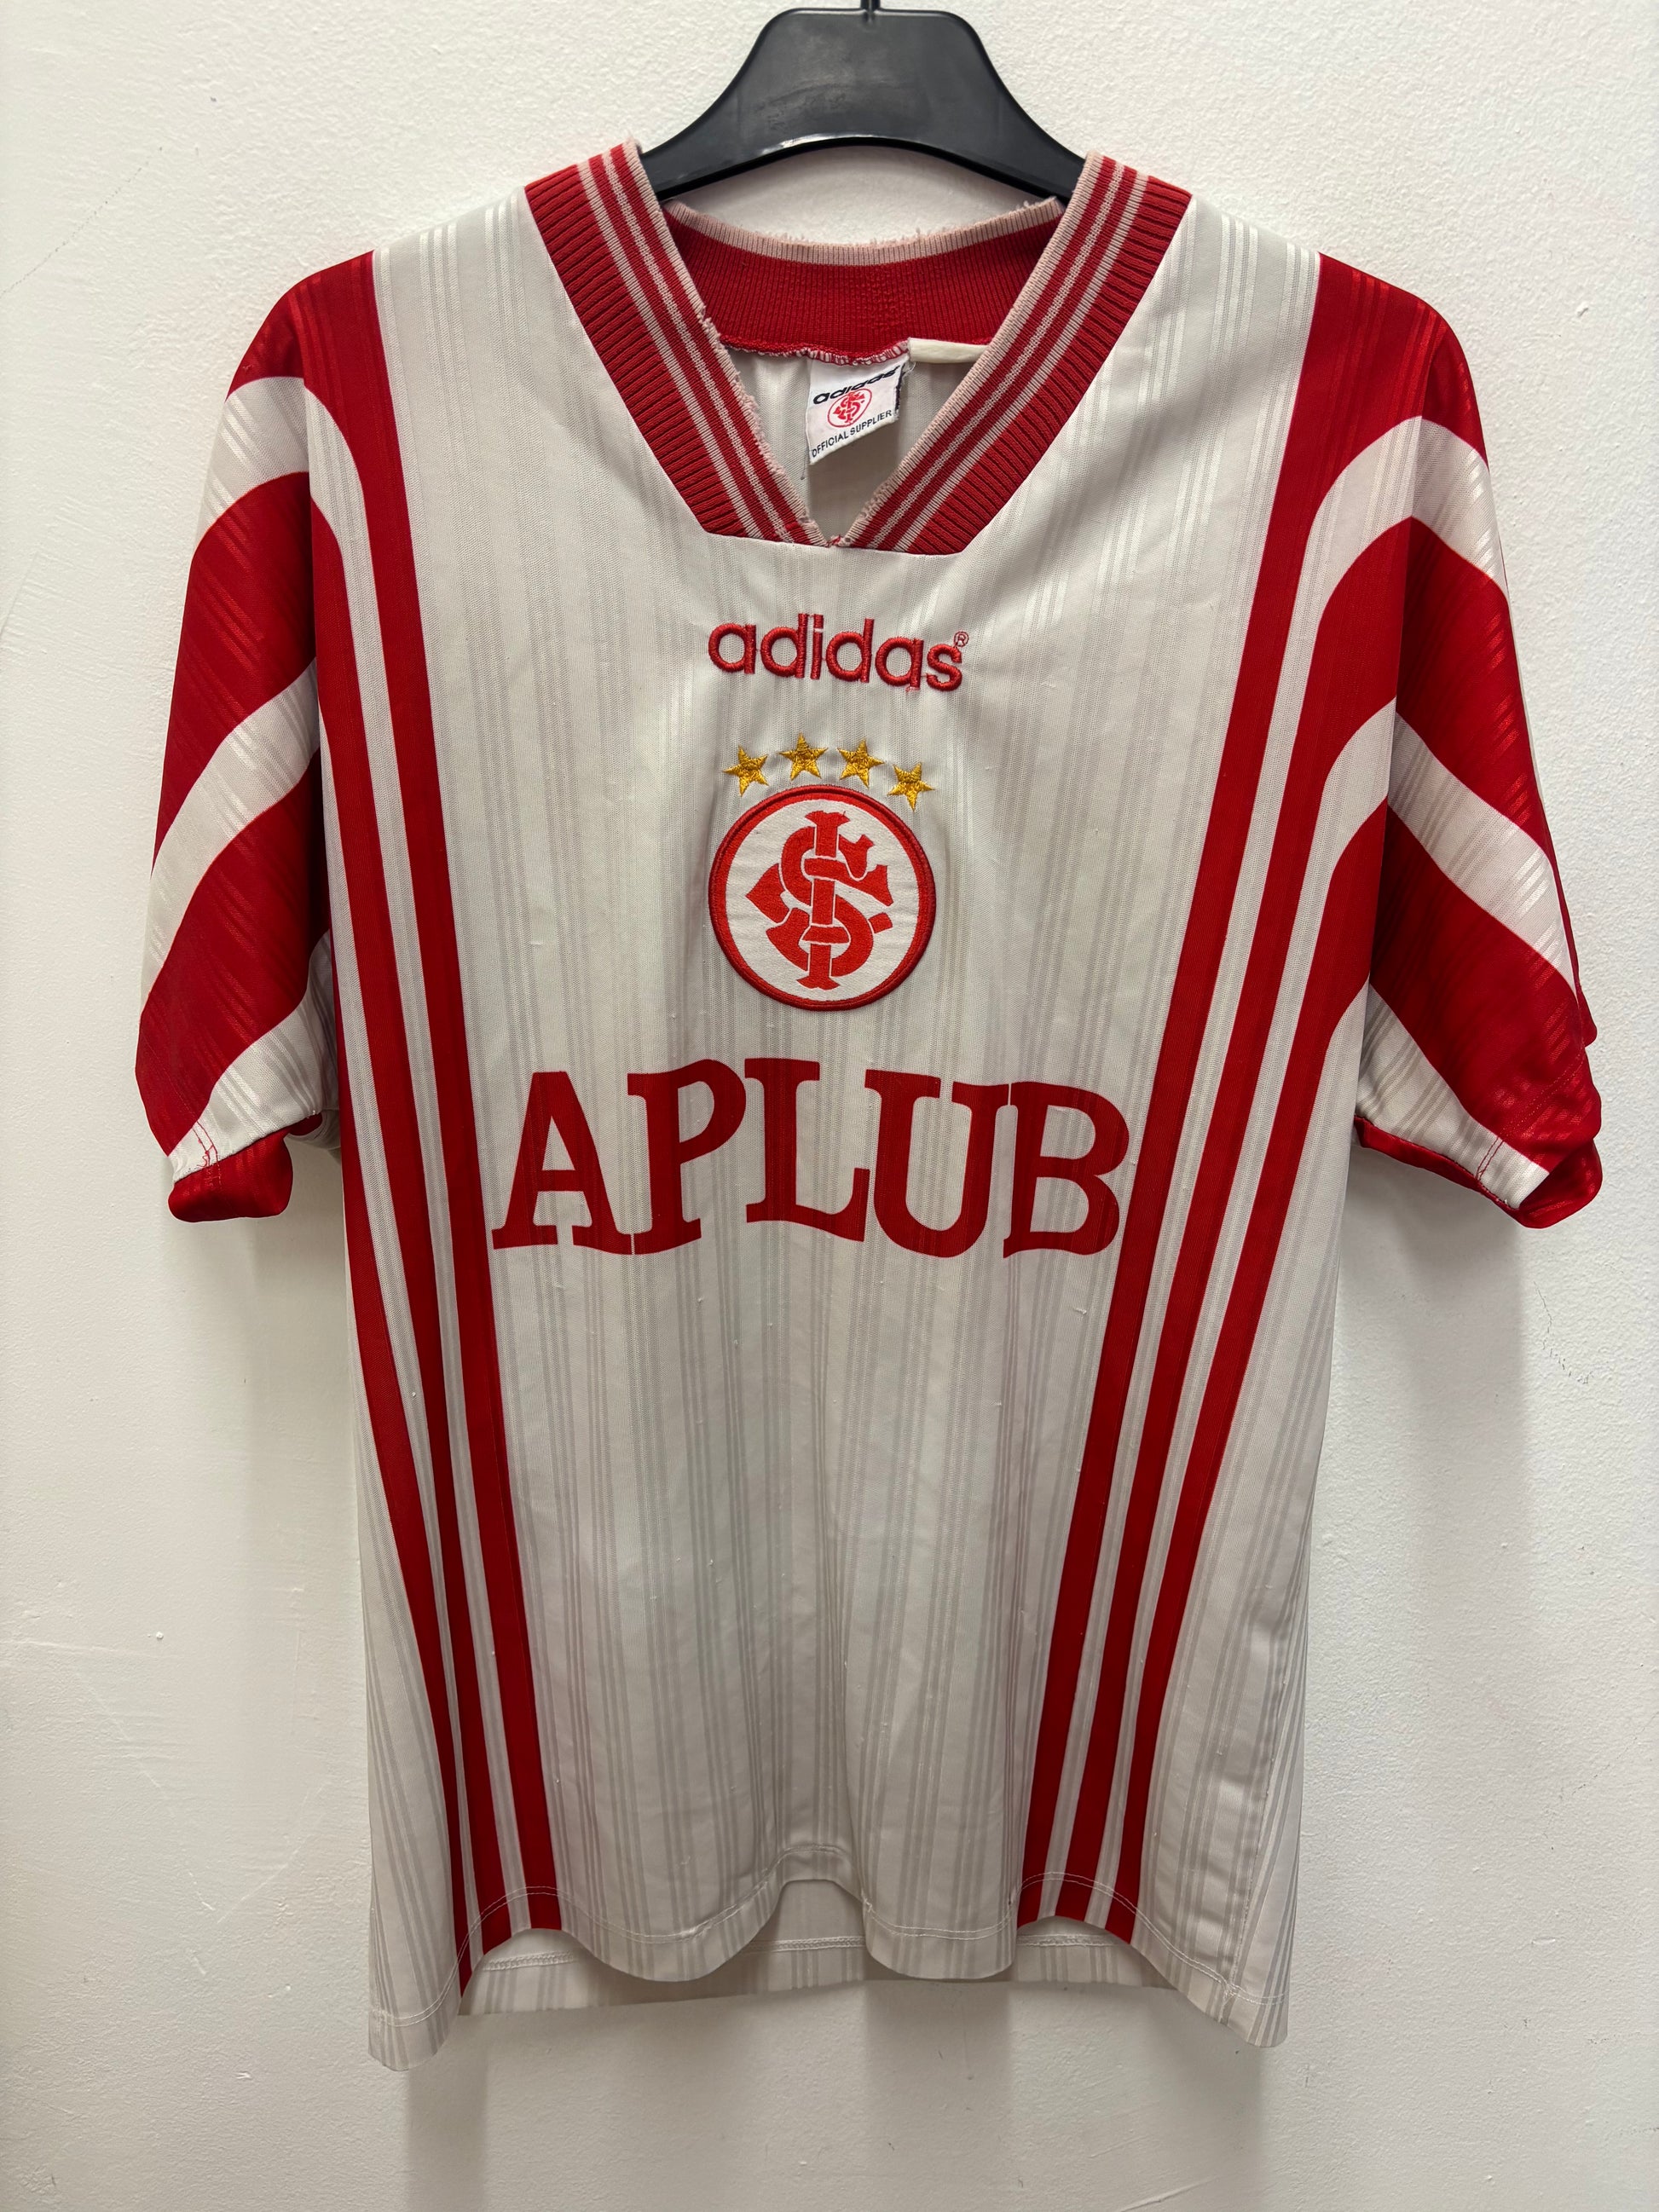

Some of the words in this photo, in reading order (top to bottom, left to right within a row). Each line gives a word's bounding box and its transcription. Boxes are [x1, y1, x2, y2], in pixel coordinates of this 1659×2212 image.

[813, 365, 899, 405] adidas
[812, 431, 848, 458] OFFICIAL
[850, 410, 892, 436] SUPPLIER
[492, 1058, 1130, 1257] APLUB
